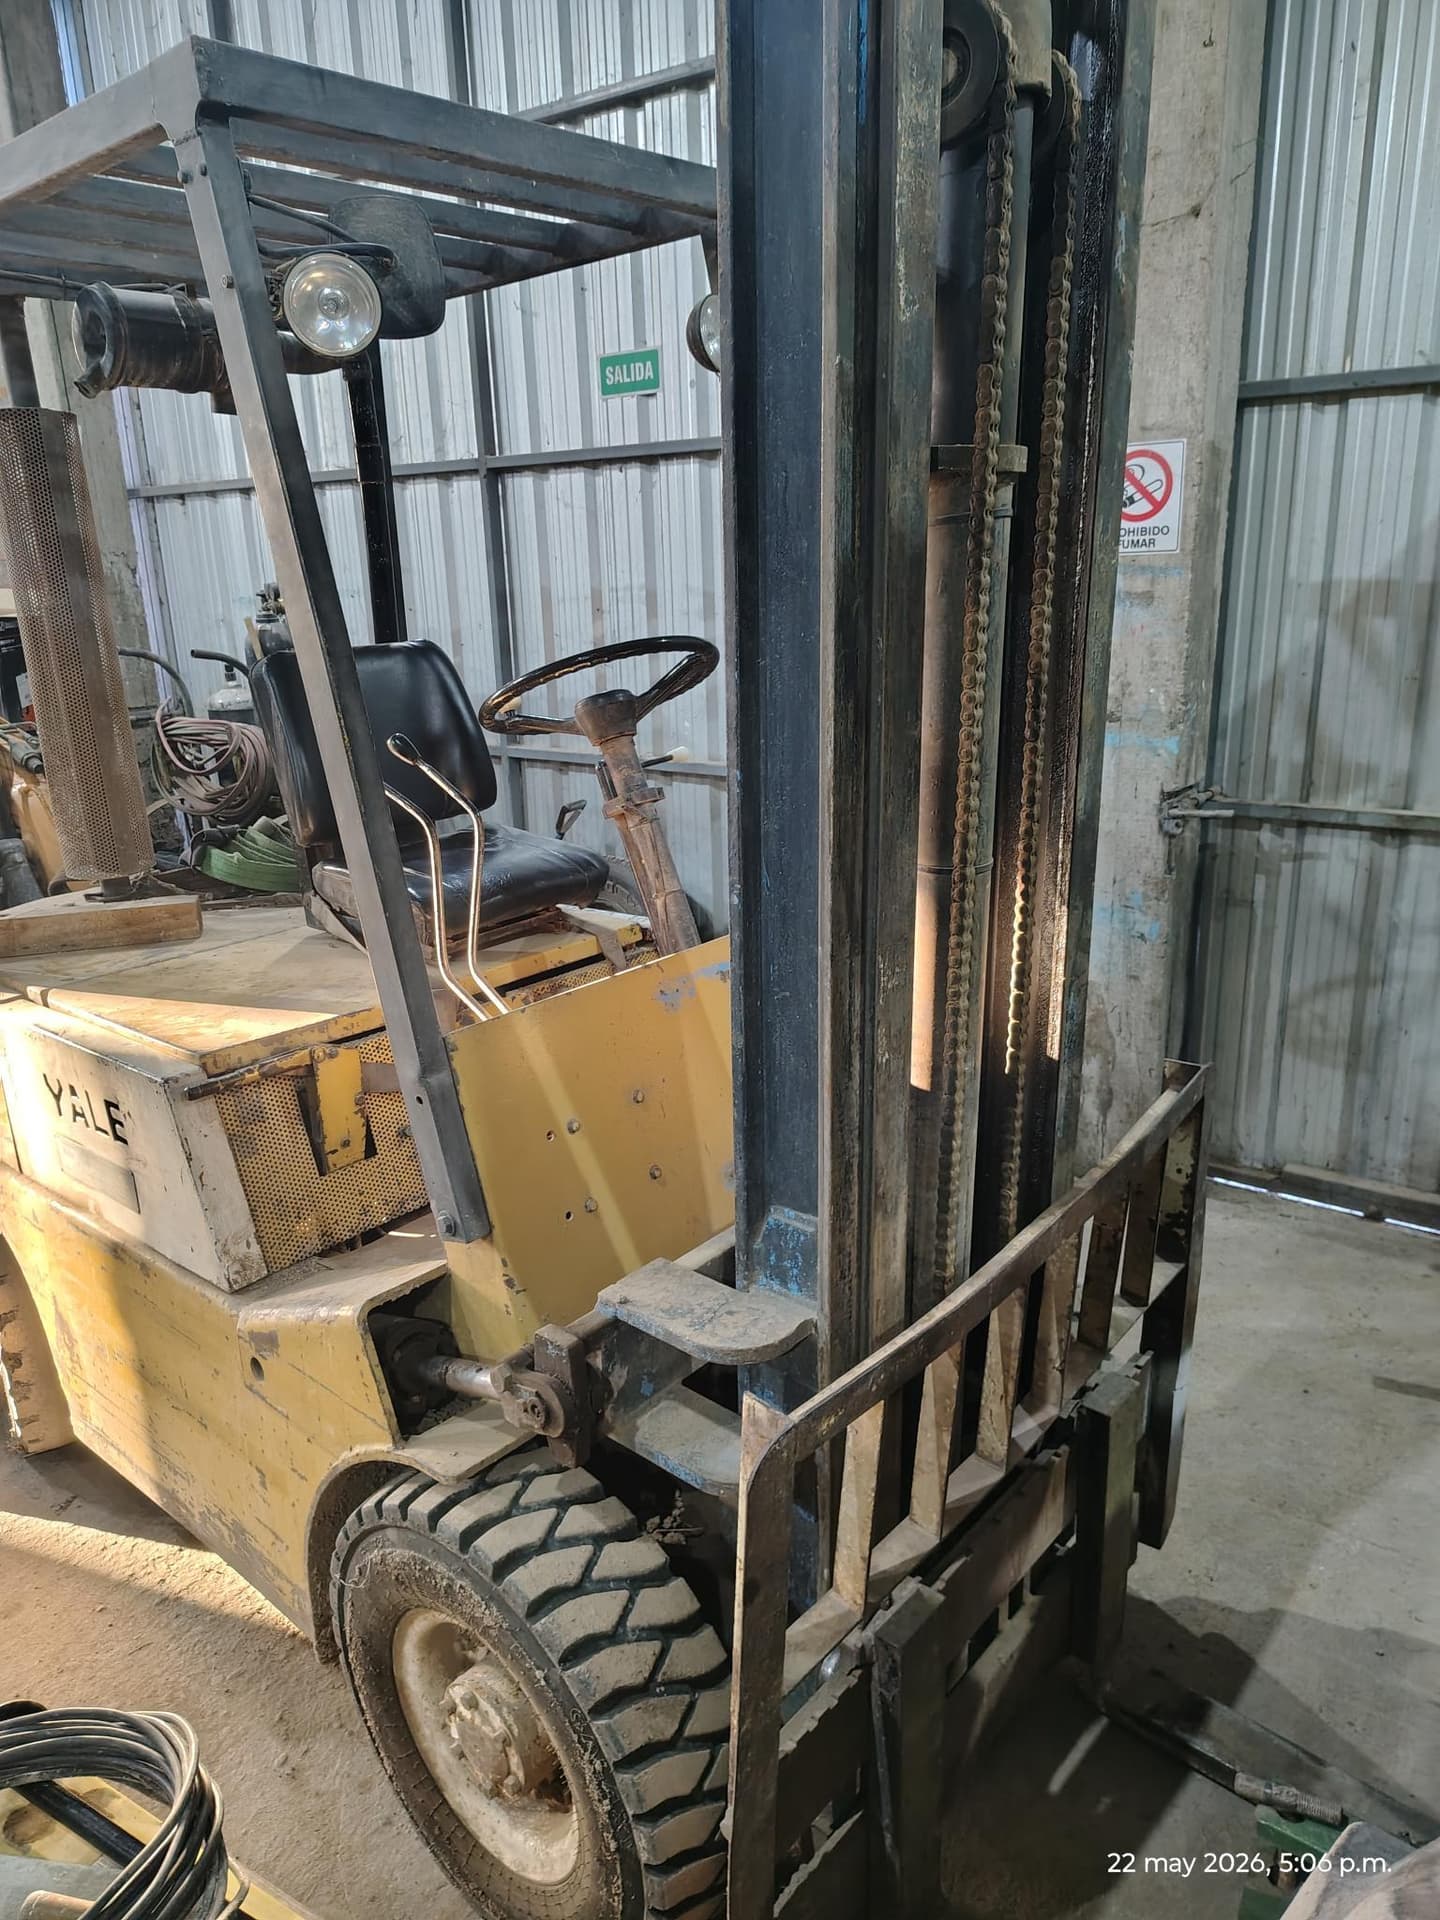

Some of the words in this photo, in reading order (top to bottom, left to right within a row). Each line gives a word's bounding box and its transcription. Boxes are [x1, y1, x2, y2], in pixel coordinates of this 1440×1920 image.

[605, 360, 654, 385] SALIDA
[1120, 525, 1170, 538] OHIBIDO
[43, 1073, 128, 1146] YALE
